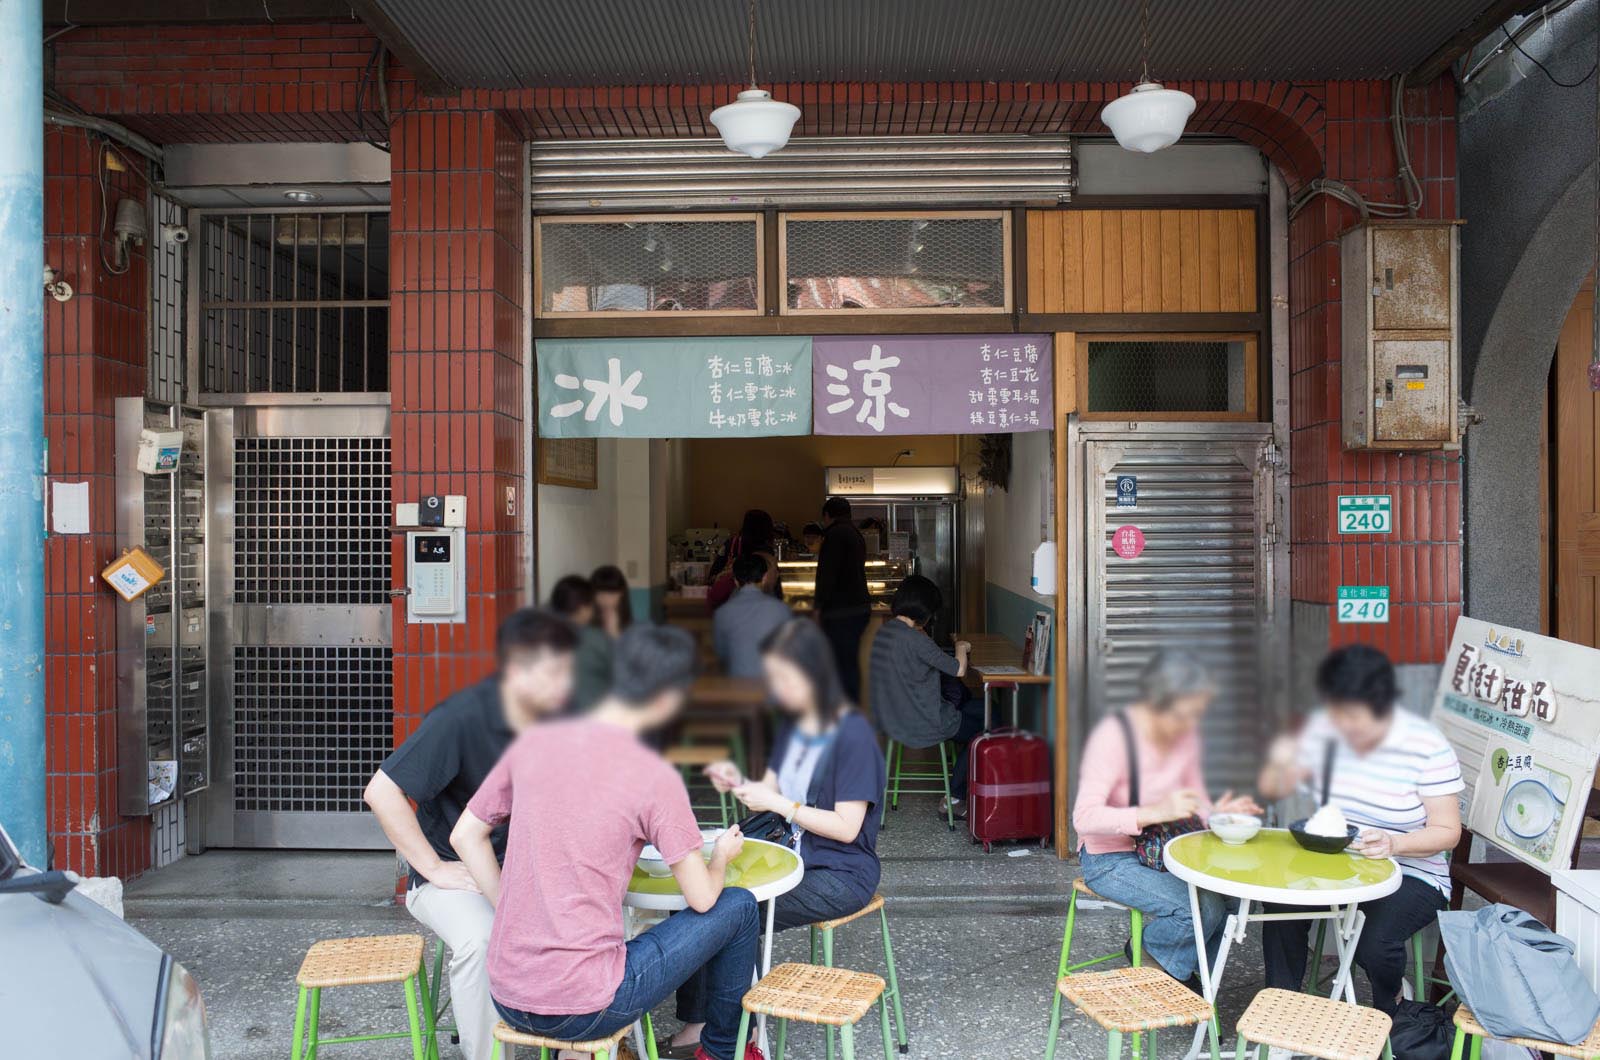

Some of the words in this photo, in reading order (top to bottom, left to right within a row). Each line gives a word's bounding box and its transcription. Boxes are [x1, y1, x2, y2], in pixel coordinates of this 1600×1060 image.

[980, 344, 1038, 363] 杏仁豆腐
[708, 354, 792, 376] 杏仁豆腐冰
[980, 367, 1039, 384] 杏仁豆花
[549, 358, 648, 426] 冰
[708, 382, 796, 403] 杏仁雪花冰
[826, 344, 910, 431] 涼
[709, 409, 797, 428] 牛奶雪花冰
[1346, 513, 1384, 530] 240
[1341, 602, 1386, 618] 240
[1452, 643, 1549, 720] 夏樹甜品
[1497, 755, 1532, 770] 杏仁豆腐
